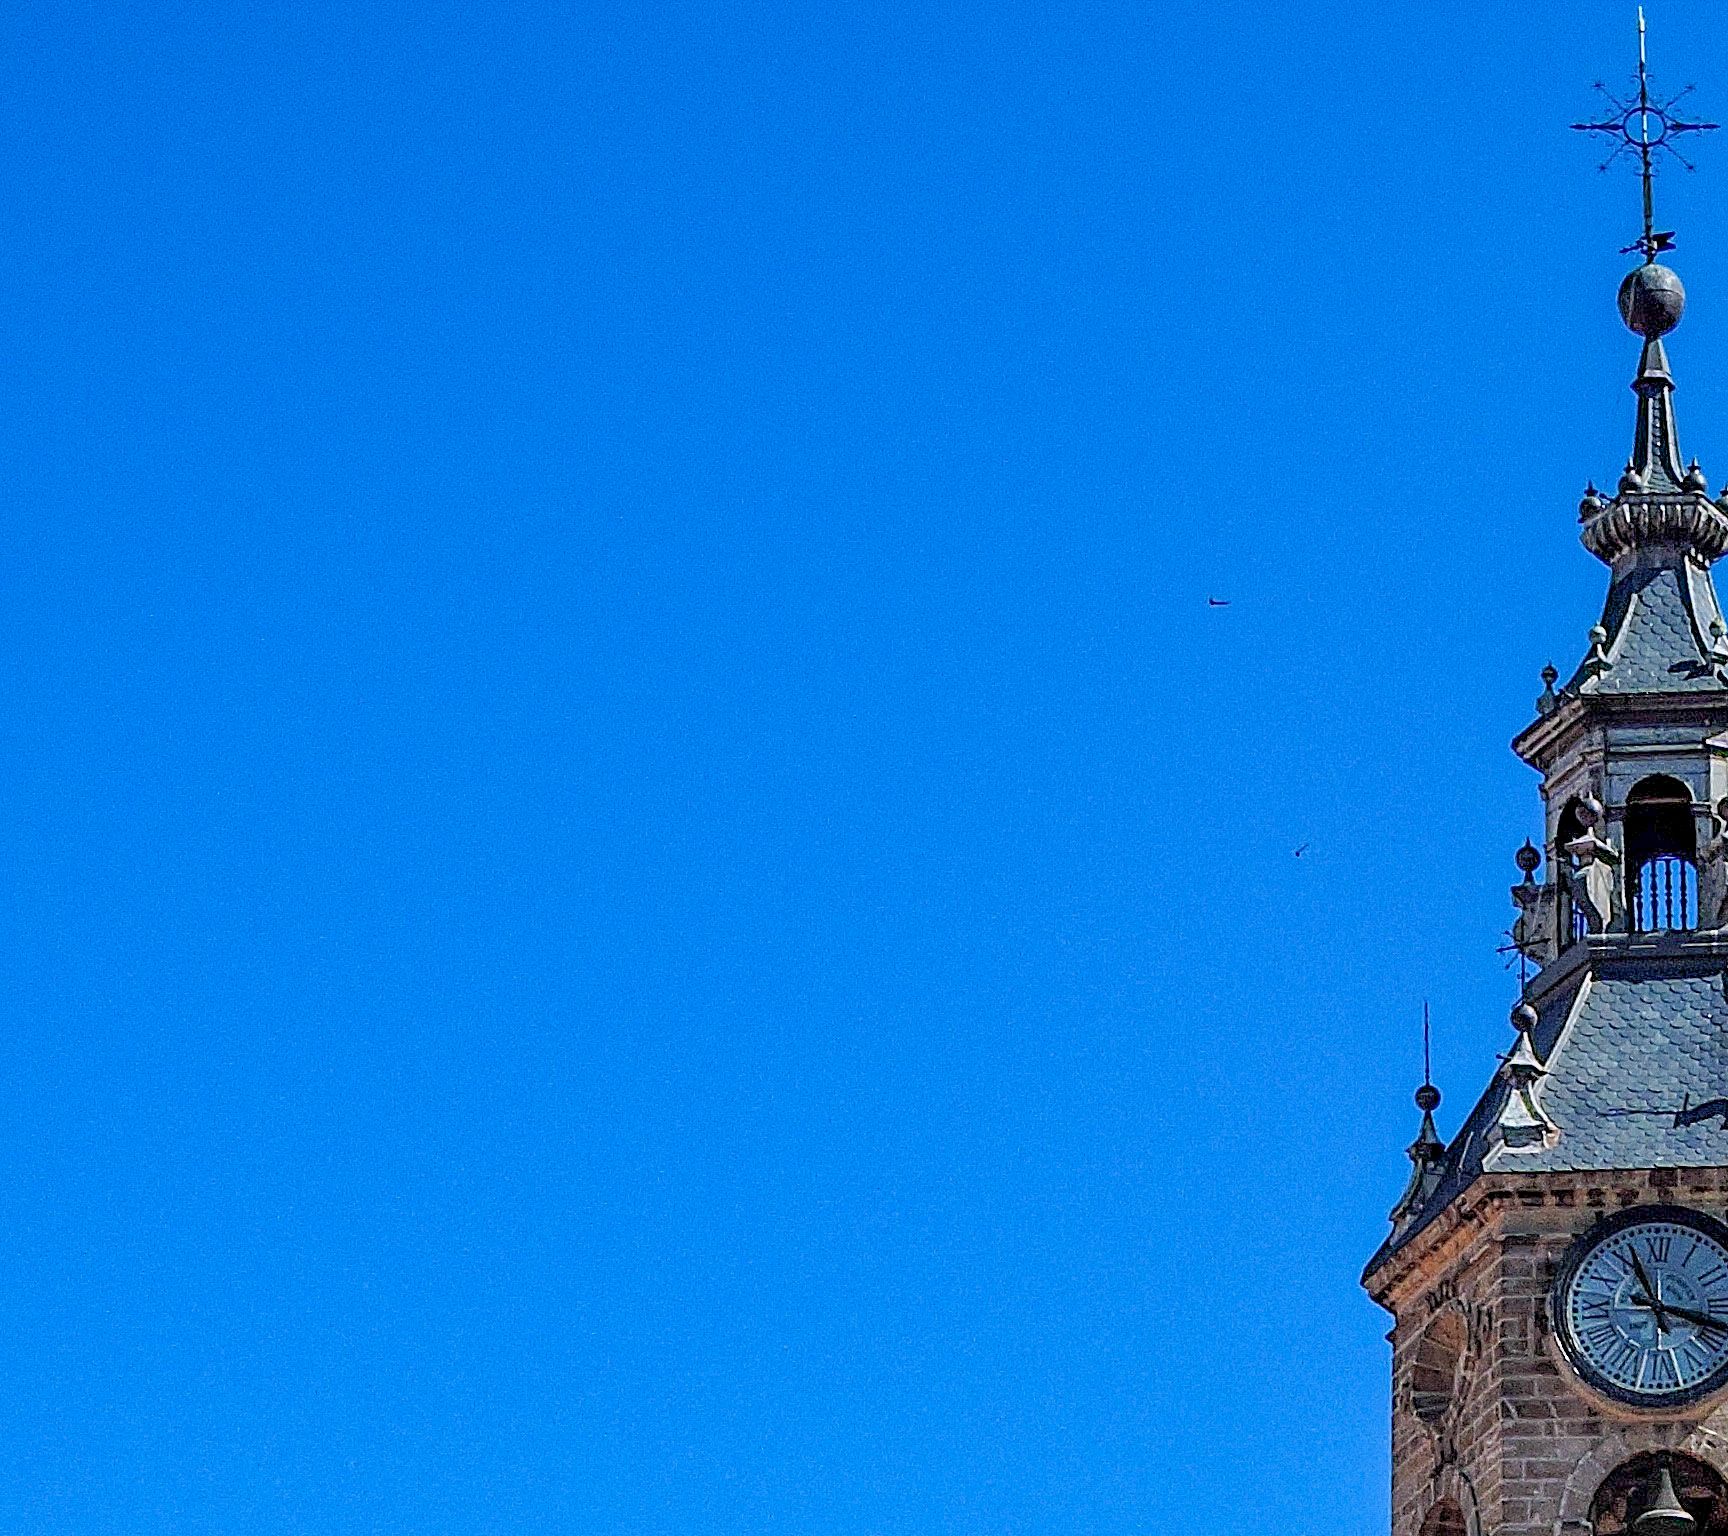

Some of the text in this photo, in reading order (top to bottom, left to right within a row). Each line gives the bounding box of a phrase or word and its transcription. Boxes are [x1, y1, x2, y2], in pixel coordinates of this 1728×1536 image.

[1645, 1236, 1671, 1263] XII
[1681, 1243, 1697, 1268] I
[1589, 1267, 1619, 1291] X
[1697, 1264, 1727, 1288] II
[1581, 1298, 1610, 1321] IX
[1651, 1352, 1675, 1380] VI
[1682, 1346, 1704, 1372] V
